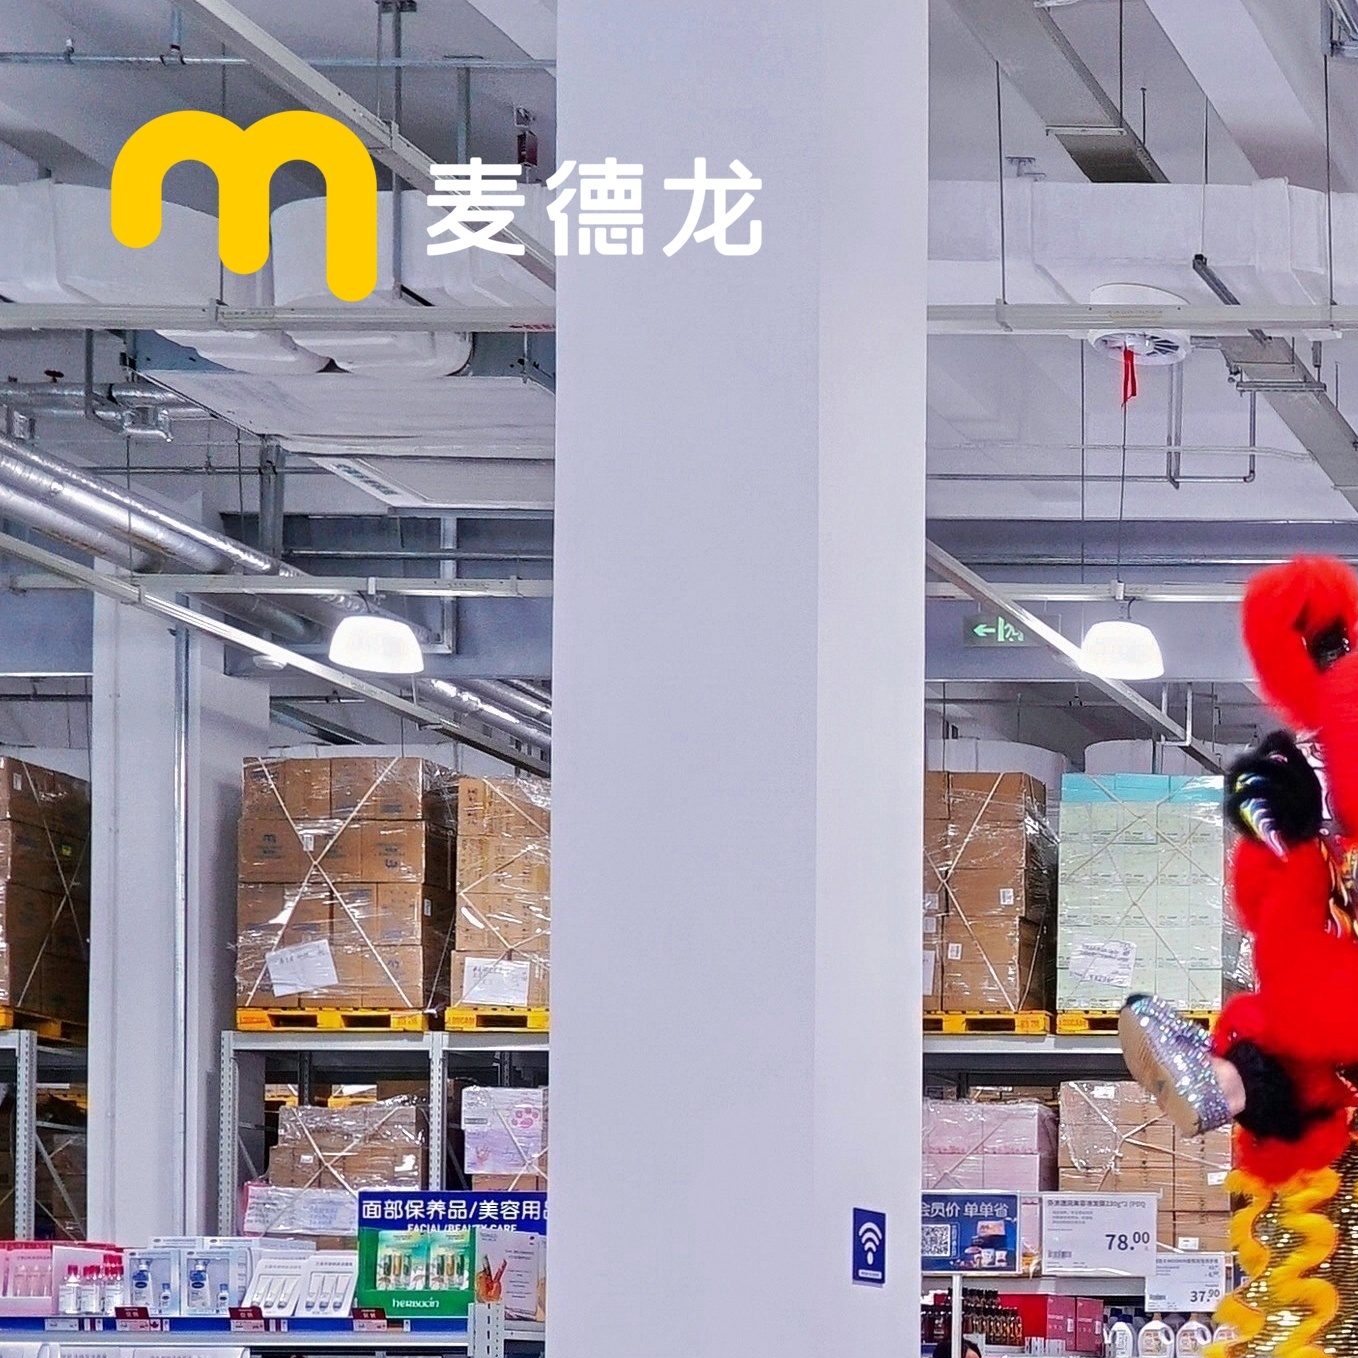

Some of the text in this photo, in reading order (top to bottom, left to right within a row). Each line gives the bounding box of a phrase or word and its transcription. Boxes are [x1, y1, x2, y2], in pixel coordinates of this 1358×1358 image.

[362, 1199, 547, 1220] 面部保养品/美容用
[963, 1202, 1009, 1218] 单单省
[1105, 1231, 1150, 1251] 78.00
[1190, 1289, 1221, 1303] 37.90
